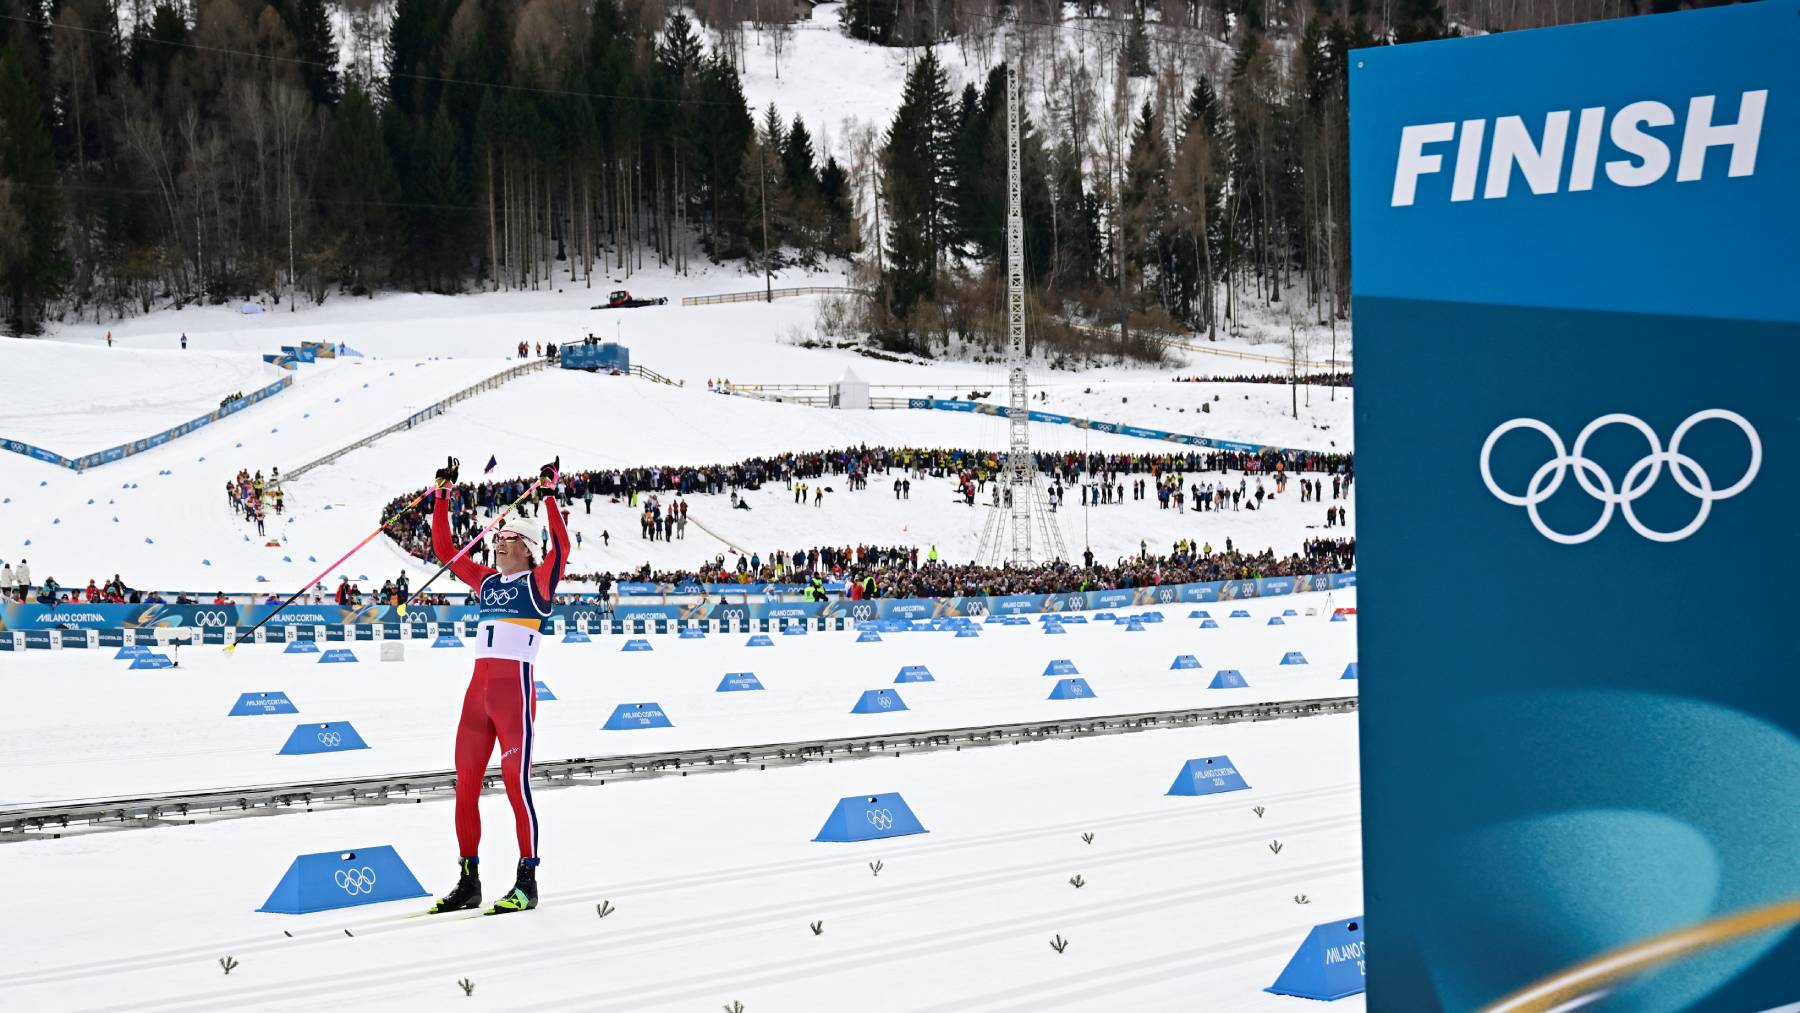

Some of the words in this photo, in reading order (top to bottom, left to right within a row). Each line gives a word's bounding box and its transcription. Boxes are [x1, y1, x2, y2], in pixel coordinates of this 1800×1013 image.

[1391, 89, 1769, 207] FINISH
[36, 614, 70, 622] MILANO
[71, 613, 105, 622] CORTINA
[296, 614, 325, 622] CORTINA
[461, 614, 480, 622] MILAN
[625, 612, 647, 620] MILANO
[647, 612, 667, 620] CORTINA
[485, 625, 494, 648] 1
[528, 634, 534, 646] 1
[1326, 942, 1361, 965] MILANO
